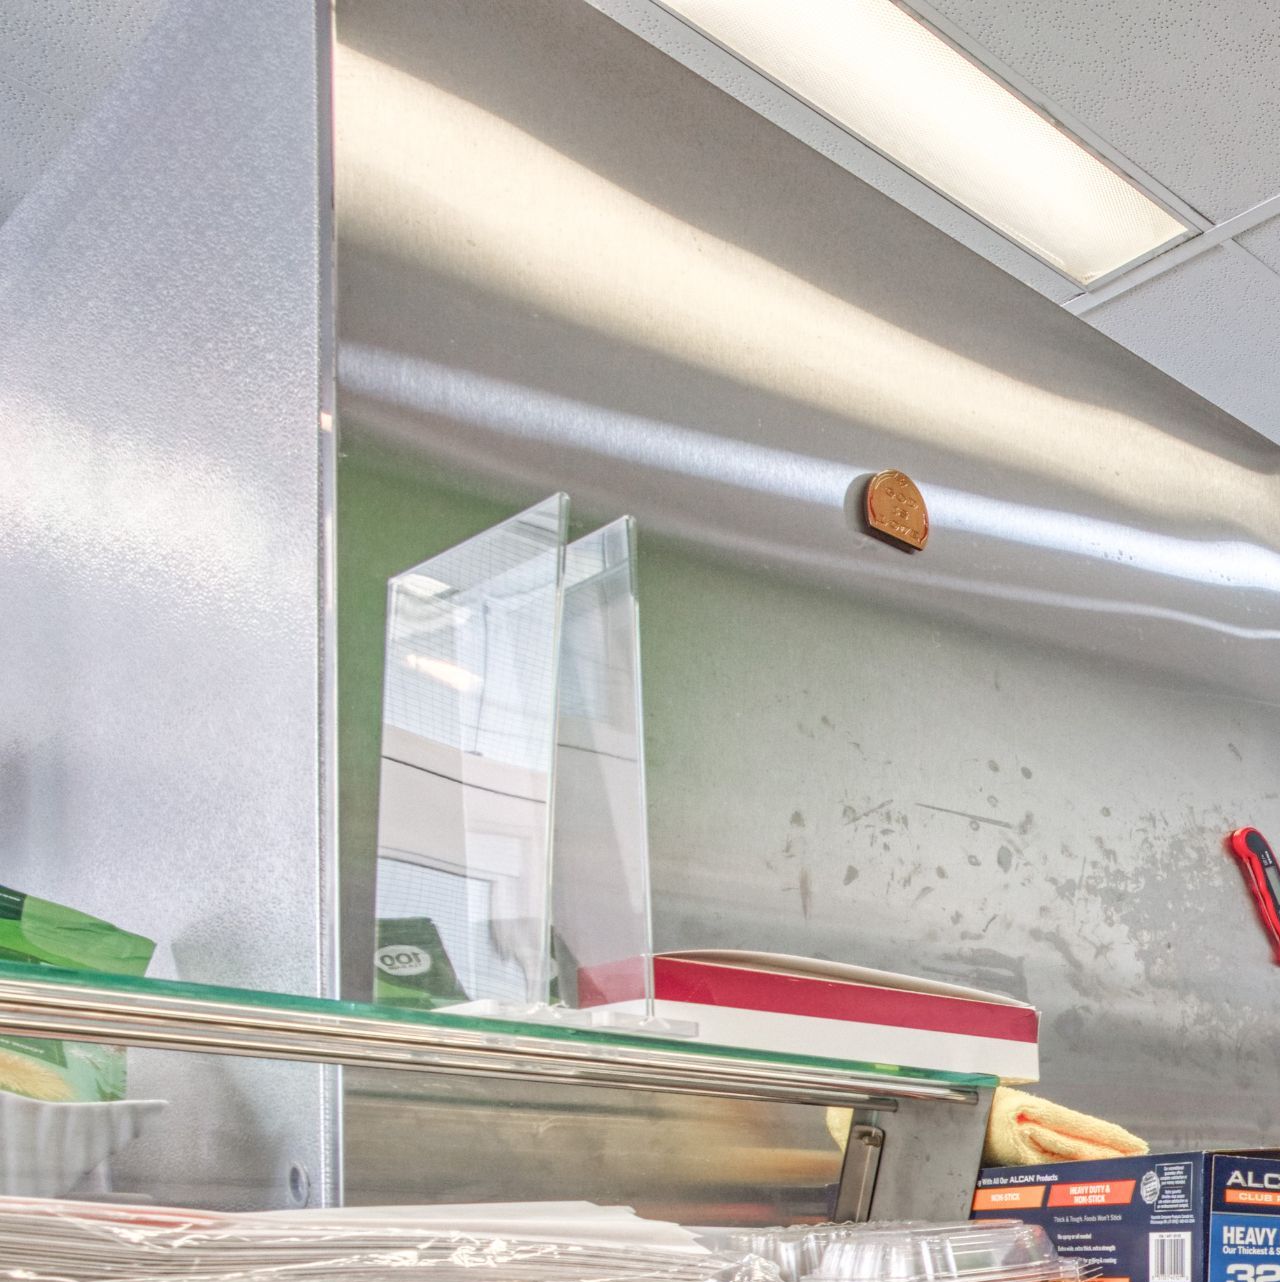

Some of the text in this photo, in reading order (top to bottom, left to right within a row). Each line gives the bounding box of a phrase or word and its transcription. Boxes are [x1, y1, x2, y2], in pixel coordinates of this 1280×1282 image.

[1009, 1175, 1035, 1183] ALCAN
[1036, 1174, 1058, 1182] Products
[1069, 1185, 1089, 1195] HEAVY
[1089, 1185, 1104, 1194] DUTY
[1239, 1192, 1273, 1202] CLUB
[1223, 1225, 1277, 1246] HEAVY
[1222, 1246, 1236, 1255] Our
[1238, 1246, 1268, 1255] Thickest
[1269, 1247, 1275, 1255] &
